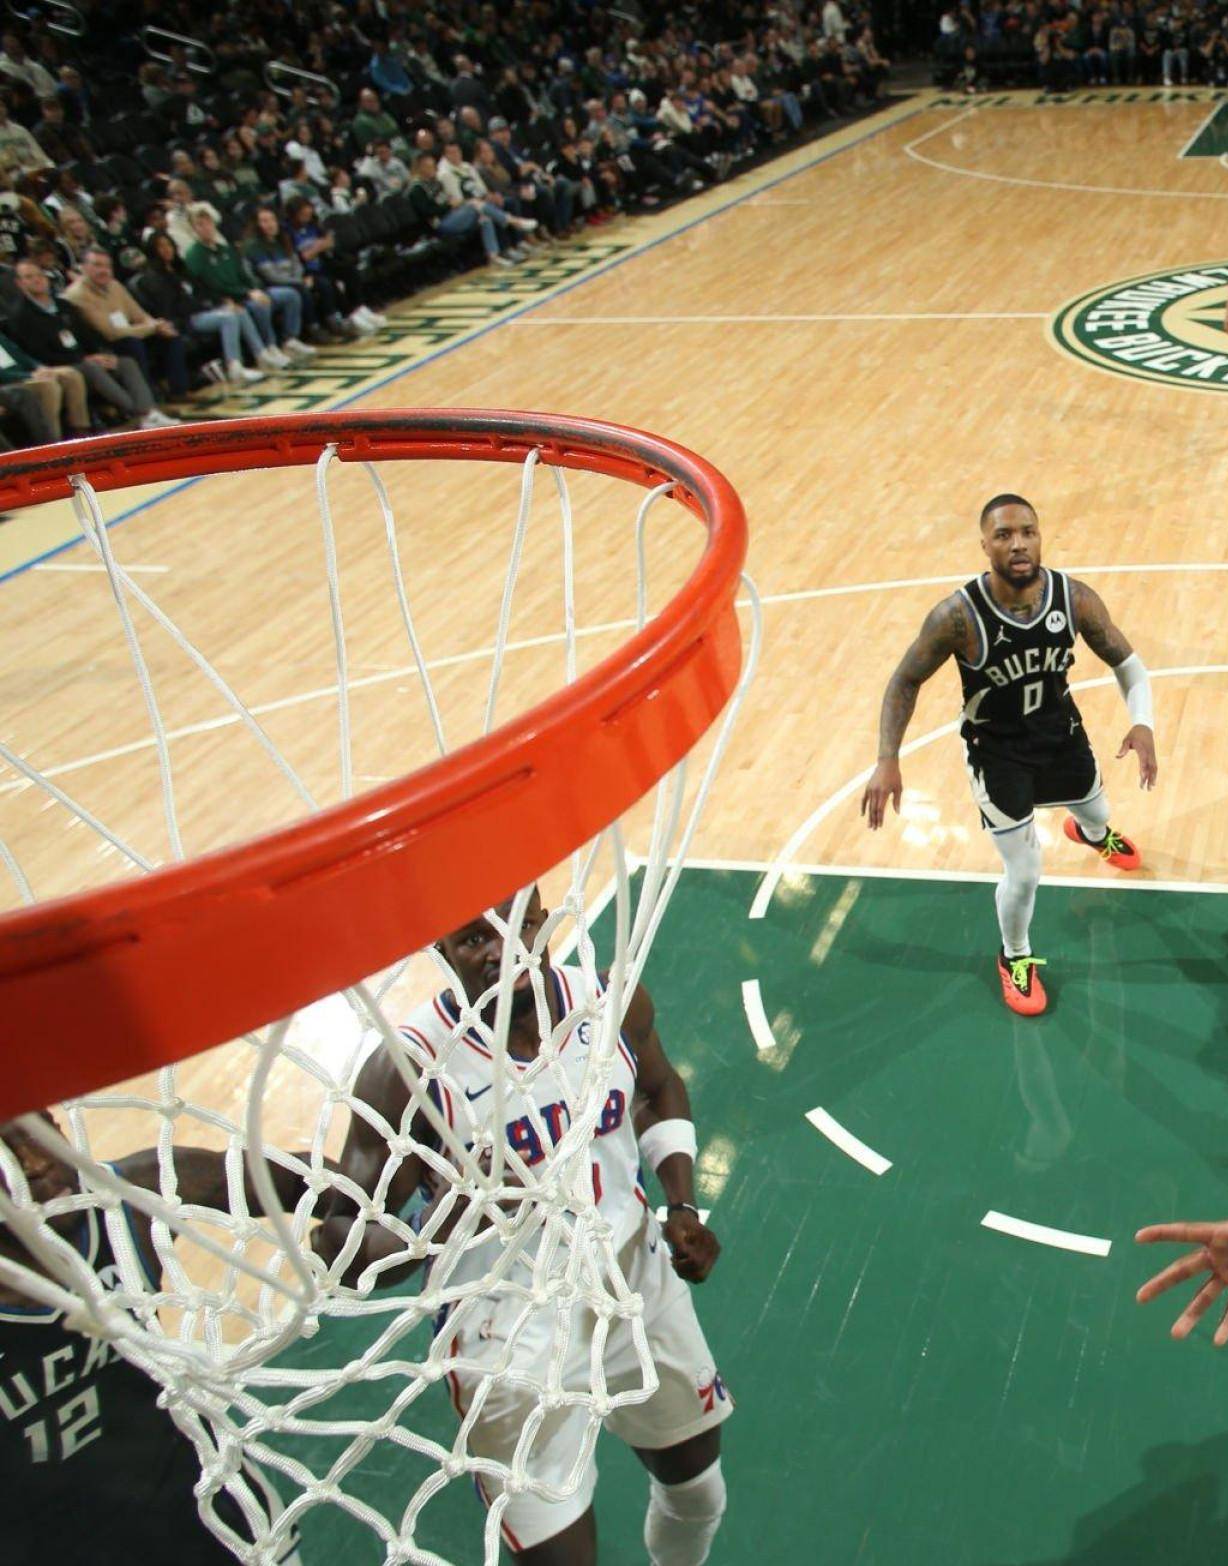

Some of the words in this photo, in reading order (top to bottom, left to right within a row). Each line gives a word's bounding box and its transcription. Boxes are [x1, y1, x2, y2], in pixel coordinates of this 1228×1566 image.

[1023, 680, 1044, 716] 0
[0, 1338, 122, 1421] UCK
[23, 1384, 102, 1463] 12
